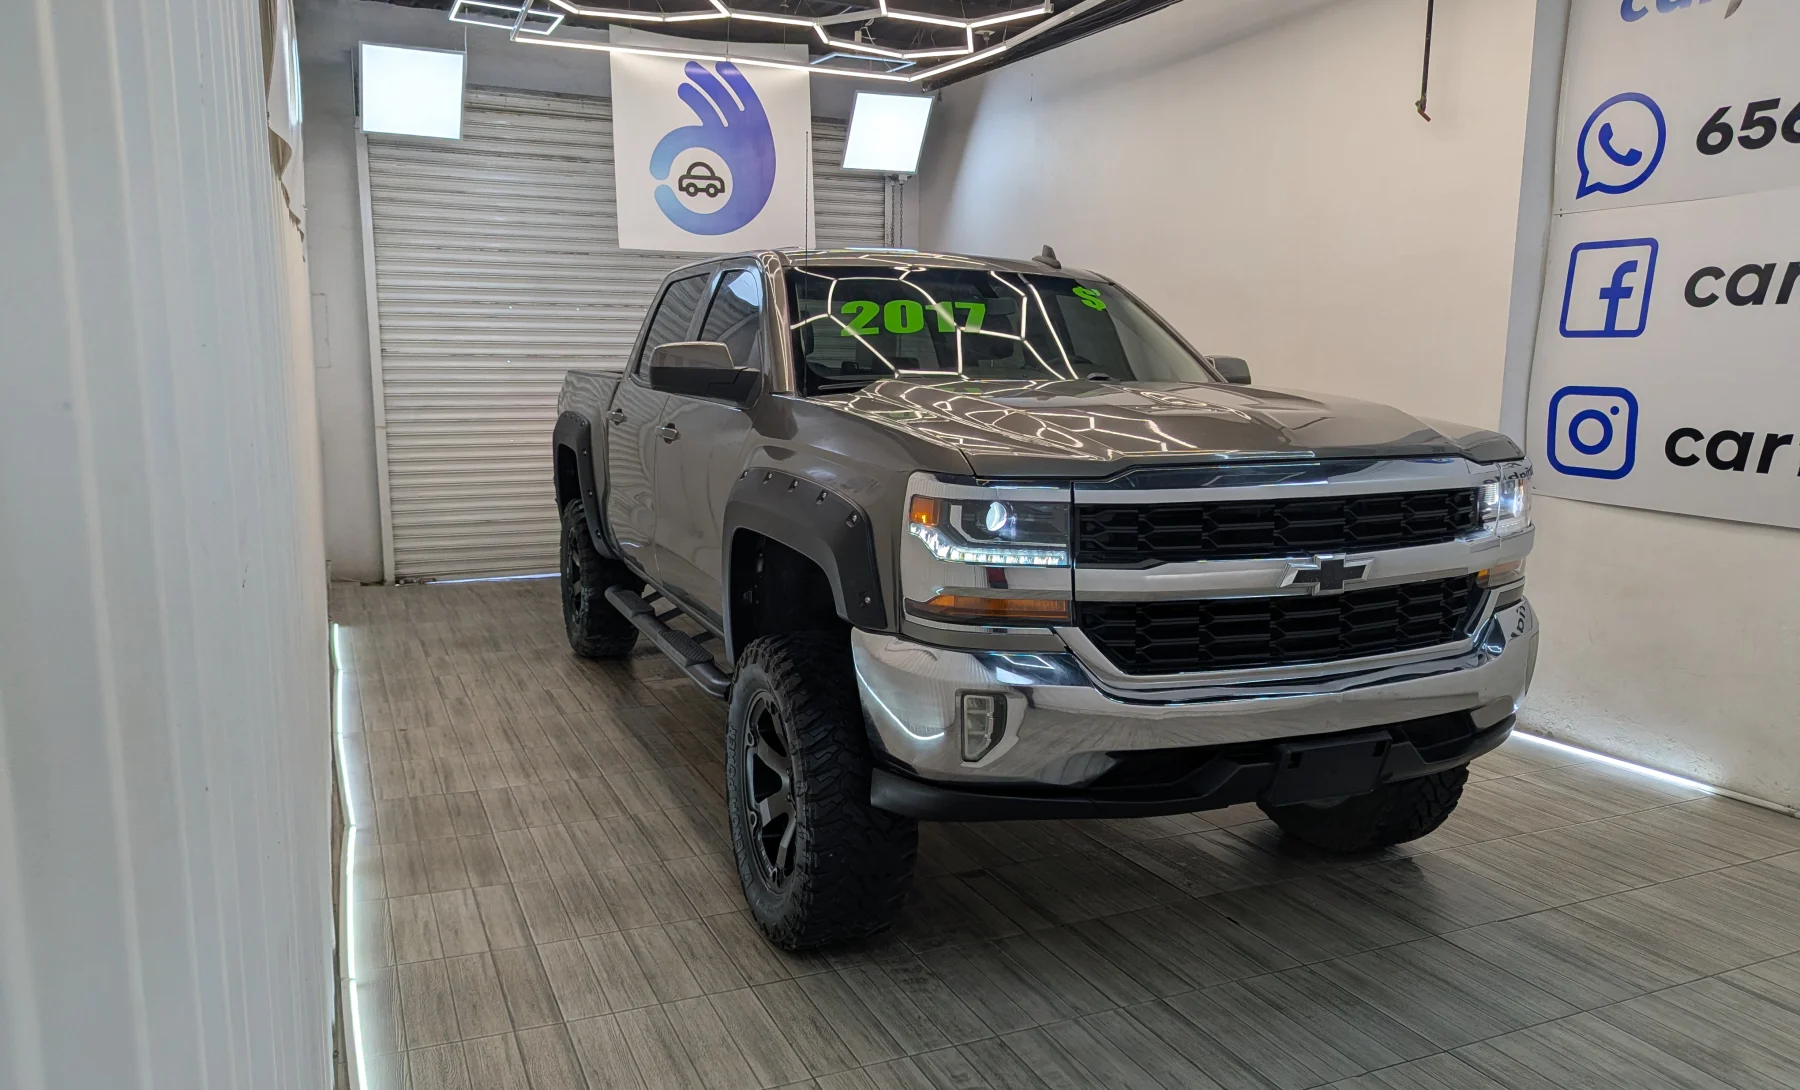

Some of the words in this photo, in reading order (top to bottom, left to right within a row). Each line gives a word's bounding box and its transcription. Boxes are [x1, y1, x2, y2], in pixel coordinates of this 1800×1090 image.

[841, 300, 986, 336] 2017
[1072, 286, 1106, 312] $
[1665, 427, 1800, 477] car
[726, 727, 737, 790] POWER
[729, 798, 748, 867] VENOM
